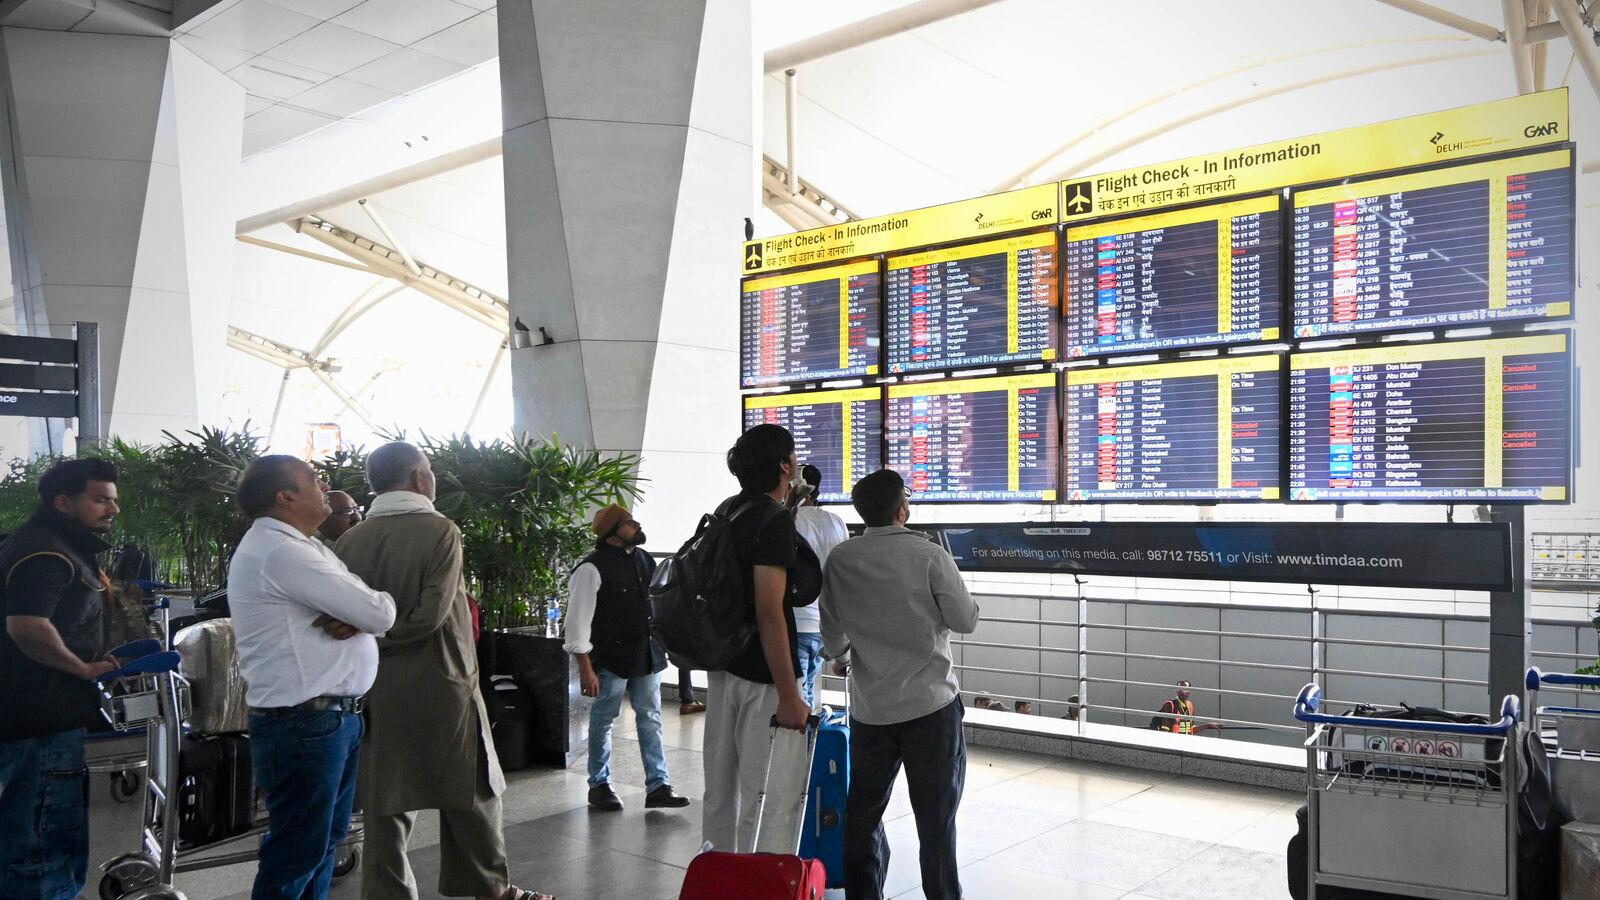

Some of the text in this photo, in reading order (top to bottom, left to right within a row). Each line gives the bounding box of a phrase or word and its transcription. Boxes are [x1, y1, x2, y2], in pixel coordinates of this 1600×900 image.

[1436, 142, 1463, 154] DELHI
[1097, 175, 1137, 193] Flight
[1142, 165, 1189, 184] Check
[1204, 160, 1218, 174] In
[1223, 141, 1321, 170] Information
[1098, 175, 1236, 211] चेक इन एवं उड़ान की जानकारी
[766, 238, 792, 253] Flight
[795, 232, 825, 247] Check
[834, 229, 844, 240] In
[847, 218, 908, 236] Information
[766, 257, 776, 267] चेक
[789, 252, 798, 263] एवं
[799, 251, 814, 263] उड़ान
[817, 246, 825, 258] की
[827, 241, 854, 256] जानकारी
[1503, 364, 1537, 372] Cancelled
[1503, 384, 1537, 392] Cancelled
[1386, 417, 1417, 425] Bengaluru
[1386, 462, 1421, 470] Guangzhou
[971, 547, 1403, 568] For advertising on this media, call: 98712 75511 or Visit: www.timdaa.com
